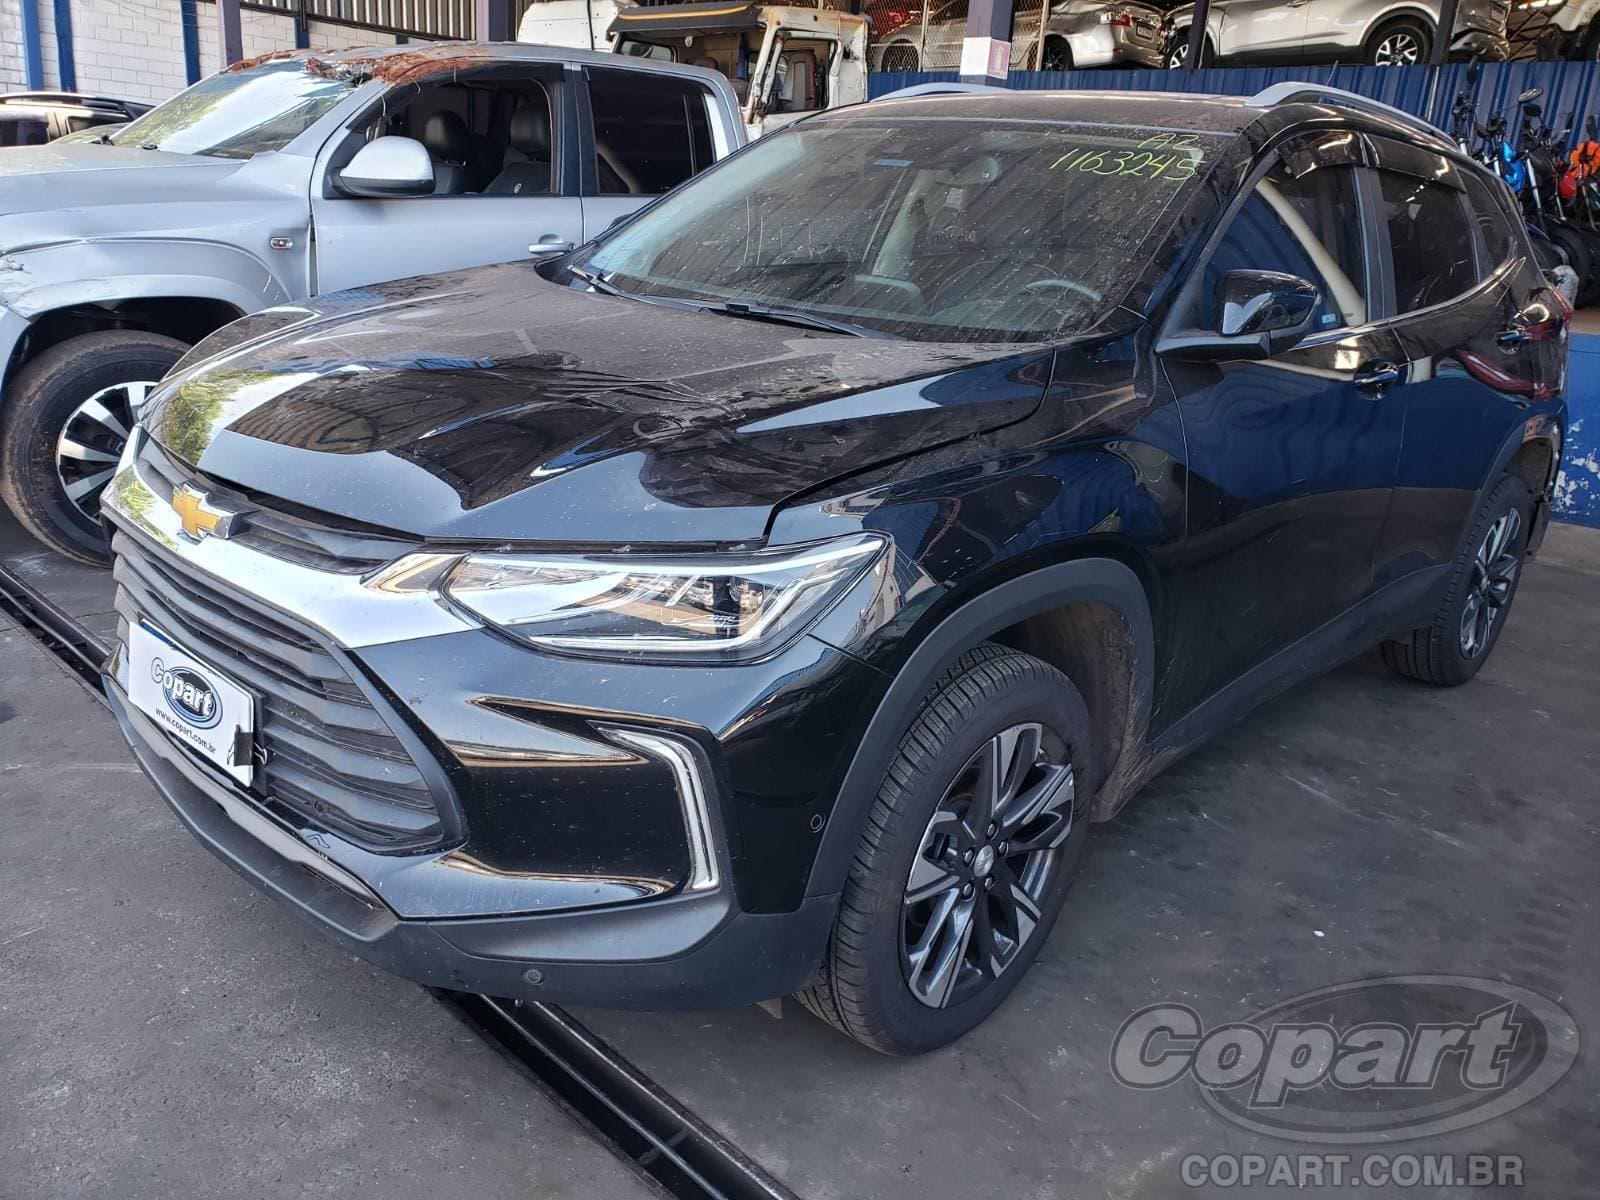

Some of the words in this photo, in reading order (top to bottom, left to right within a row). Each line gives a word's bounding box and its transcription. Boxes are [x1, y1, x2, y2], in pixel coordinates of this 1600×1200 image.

[1049, 148, 1206, 180] 1163245
[151, 657, 214, 717] Copart
[155, 707, 216, 755] www.copart.com.br
